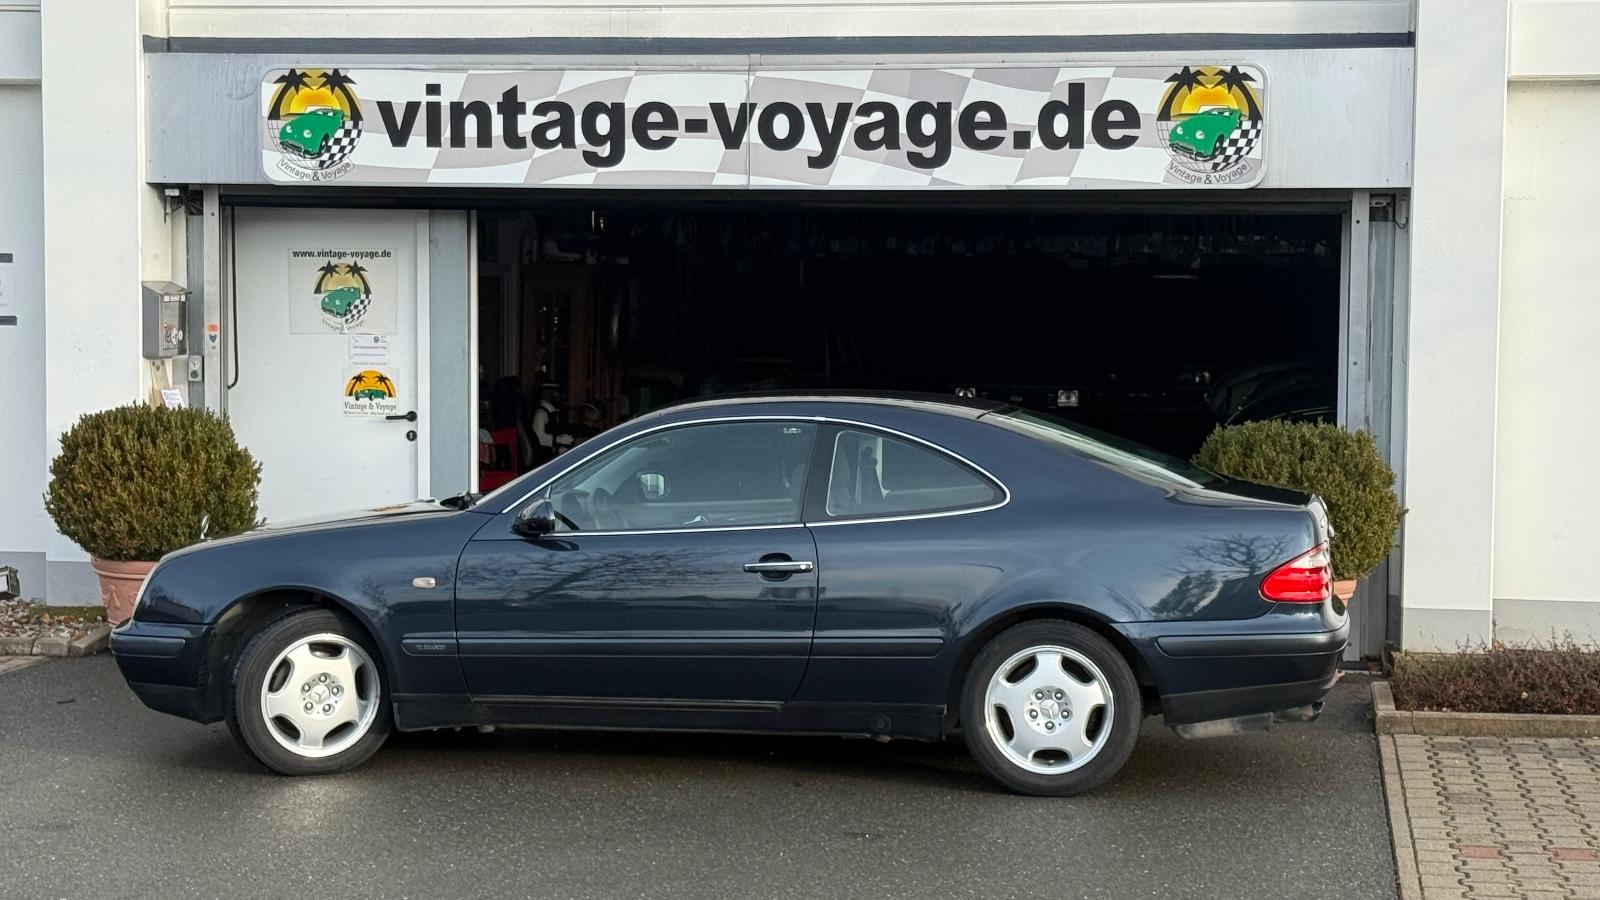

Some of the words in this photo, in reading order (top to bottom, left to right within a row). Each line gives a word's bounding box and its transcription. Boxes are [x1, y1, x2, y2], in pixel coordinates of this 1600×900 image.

[376, 83, 1141, 168] vintage-voyage.de
[280, 160, 311, 180] Vintage
[312, 171, 320, 181] &
[321, 161, 352, 180] Voyage
[1169, 162, 1202, 182] Vintage
[1204, 174, 1212, 184] &
[1214, 162, 1248, 183] Voyage
[292, 249, 392, 259] www.vintage-voyage.de
[344, 402, 367, 411] Vintage
[369, 402, 375, 410] &
[375, 402, 397, 411] Voyage
